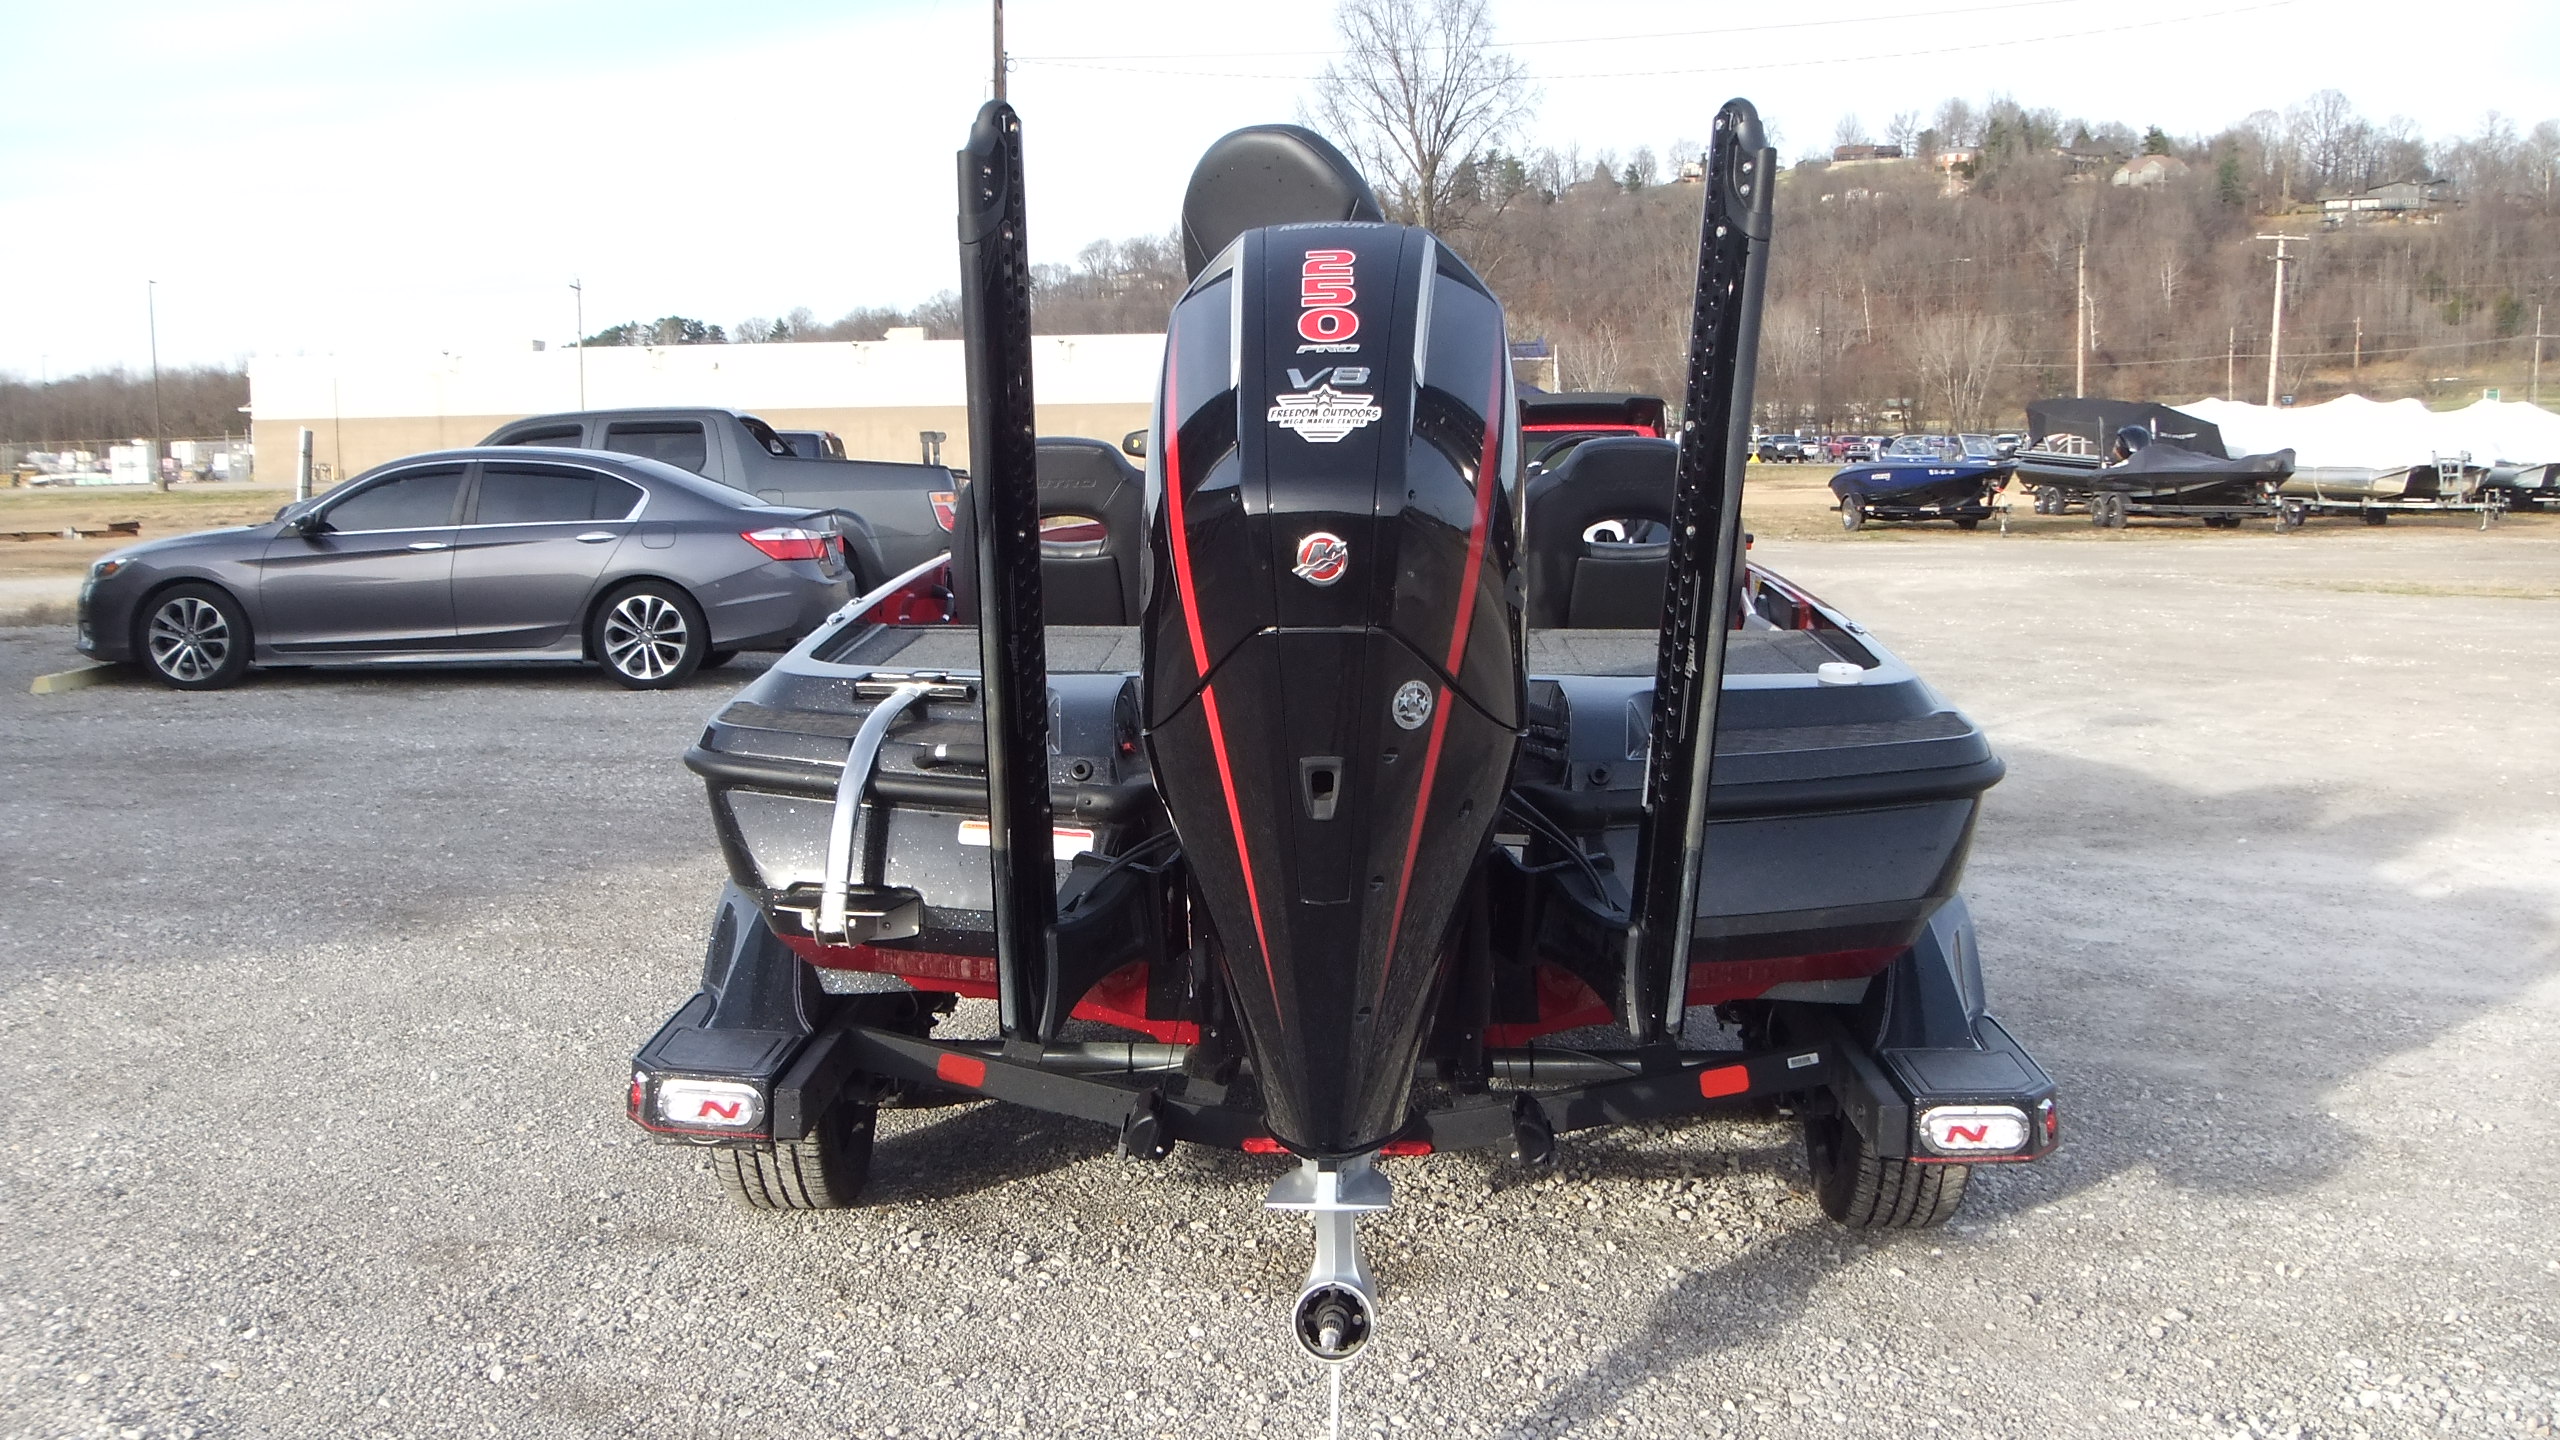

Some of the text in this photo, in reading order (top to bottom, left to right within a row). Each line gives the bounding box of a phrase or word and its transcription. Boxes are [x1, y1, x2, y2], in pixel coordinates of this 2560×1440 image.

[1297, 249, 1360, 343] 250
[1296, 344, 1360, 354] PRO
[1286, 367, 1371, 389] V8
[1270, 408, 1379, 419] FREEDOM OUTDOORS
[1684, 637, 1698, 679] Blade
